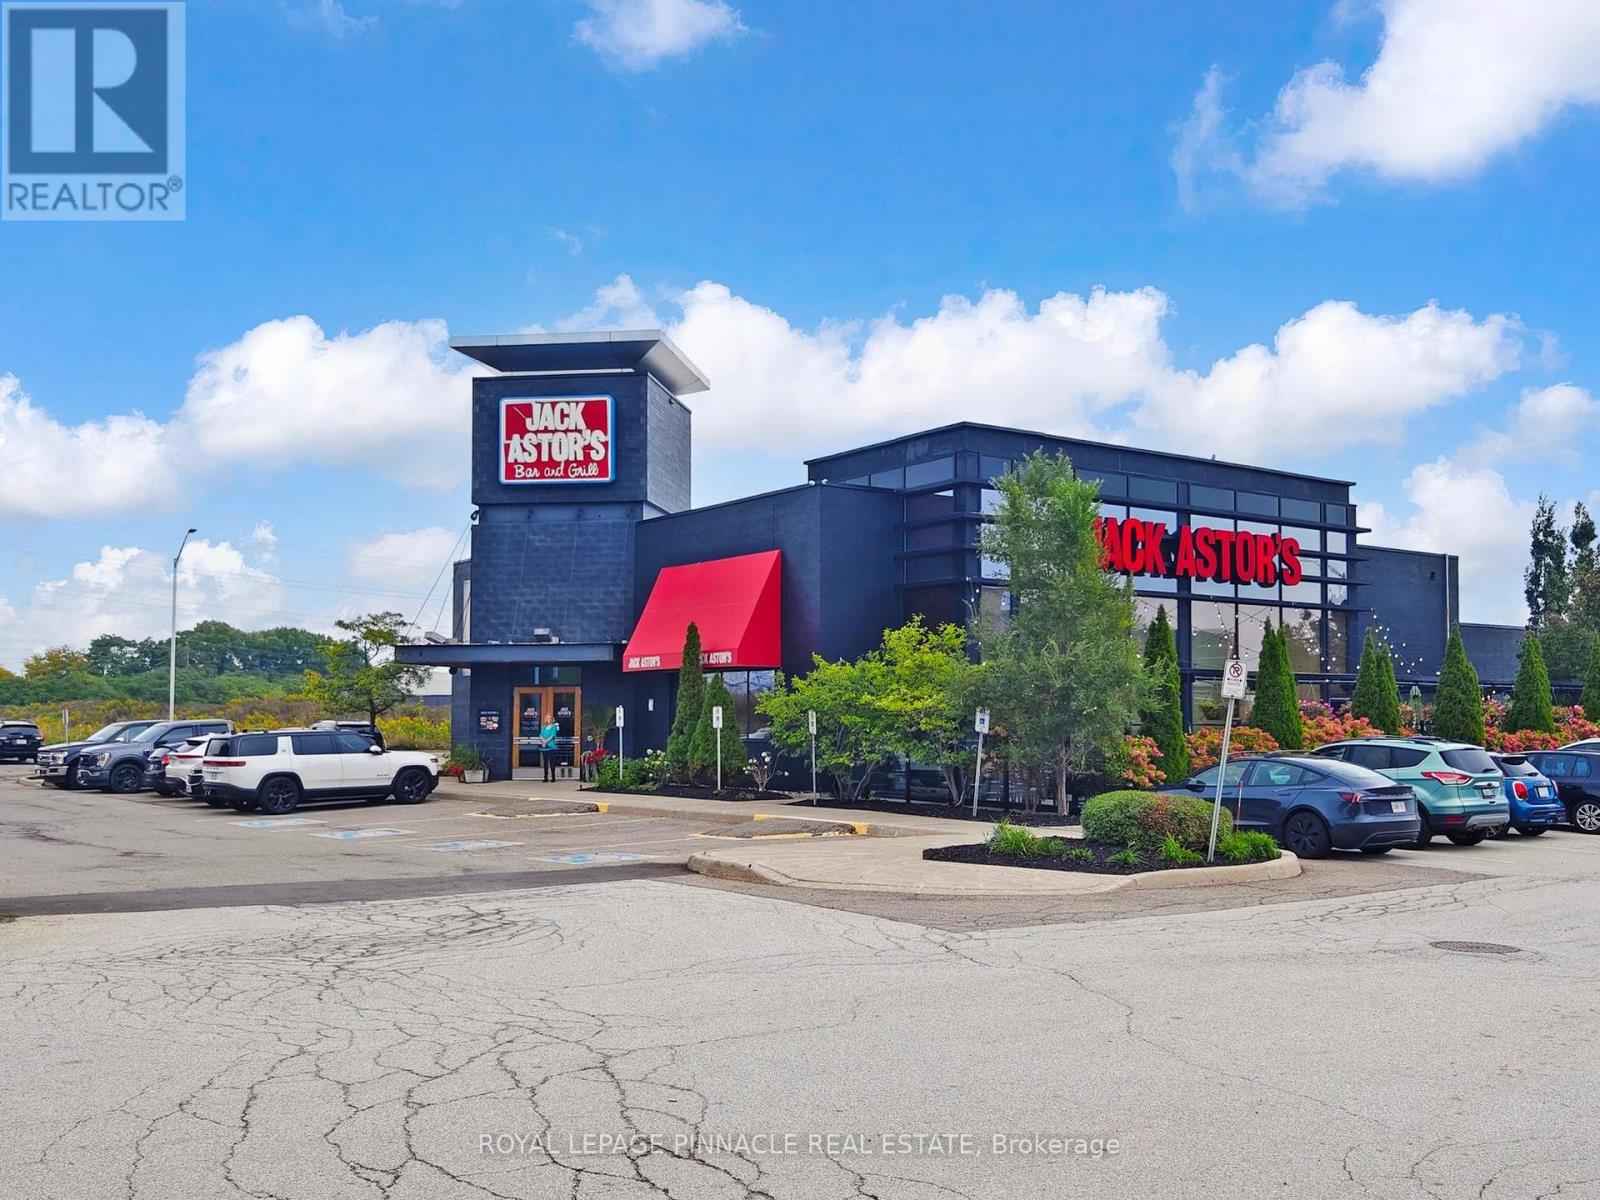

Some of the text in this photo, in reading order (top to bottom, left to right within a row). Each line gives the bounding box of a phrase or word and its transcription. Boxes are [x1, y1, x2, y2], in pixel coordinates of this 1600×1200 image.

[525, 401, 587, 431] JACK
[507, 429, 606, 463] ASTOR'S
[513, 460, 599, 479] Bar and Grill
[1175, 523, 1302, 587] ASTOR'S
[708, 651, 733, 665] ASTOR'S
